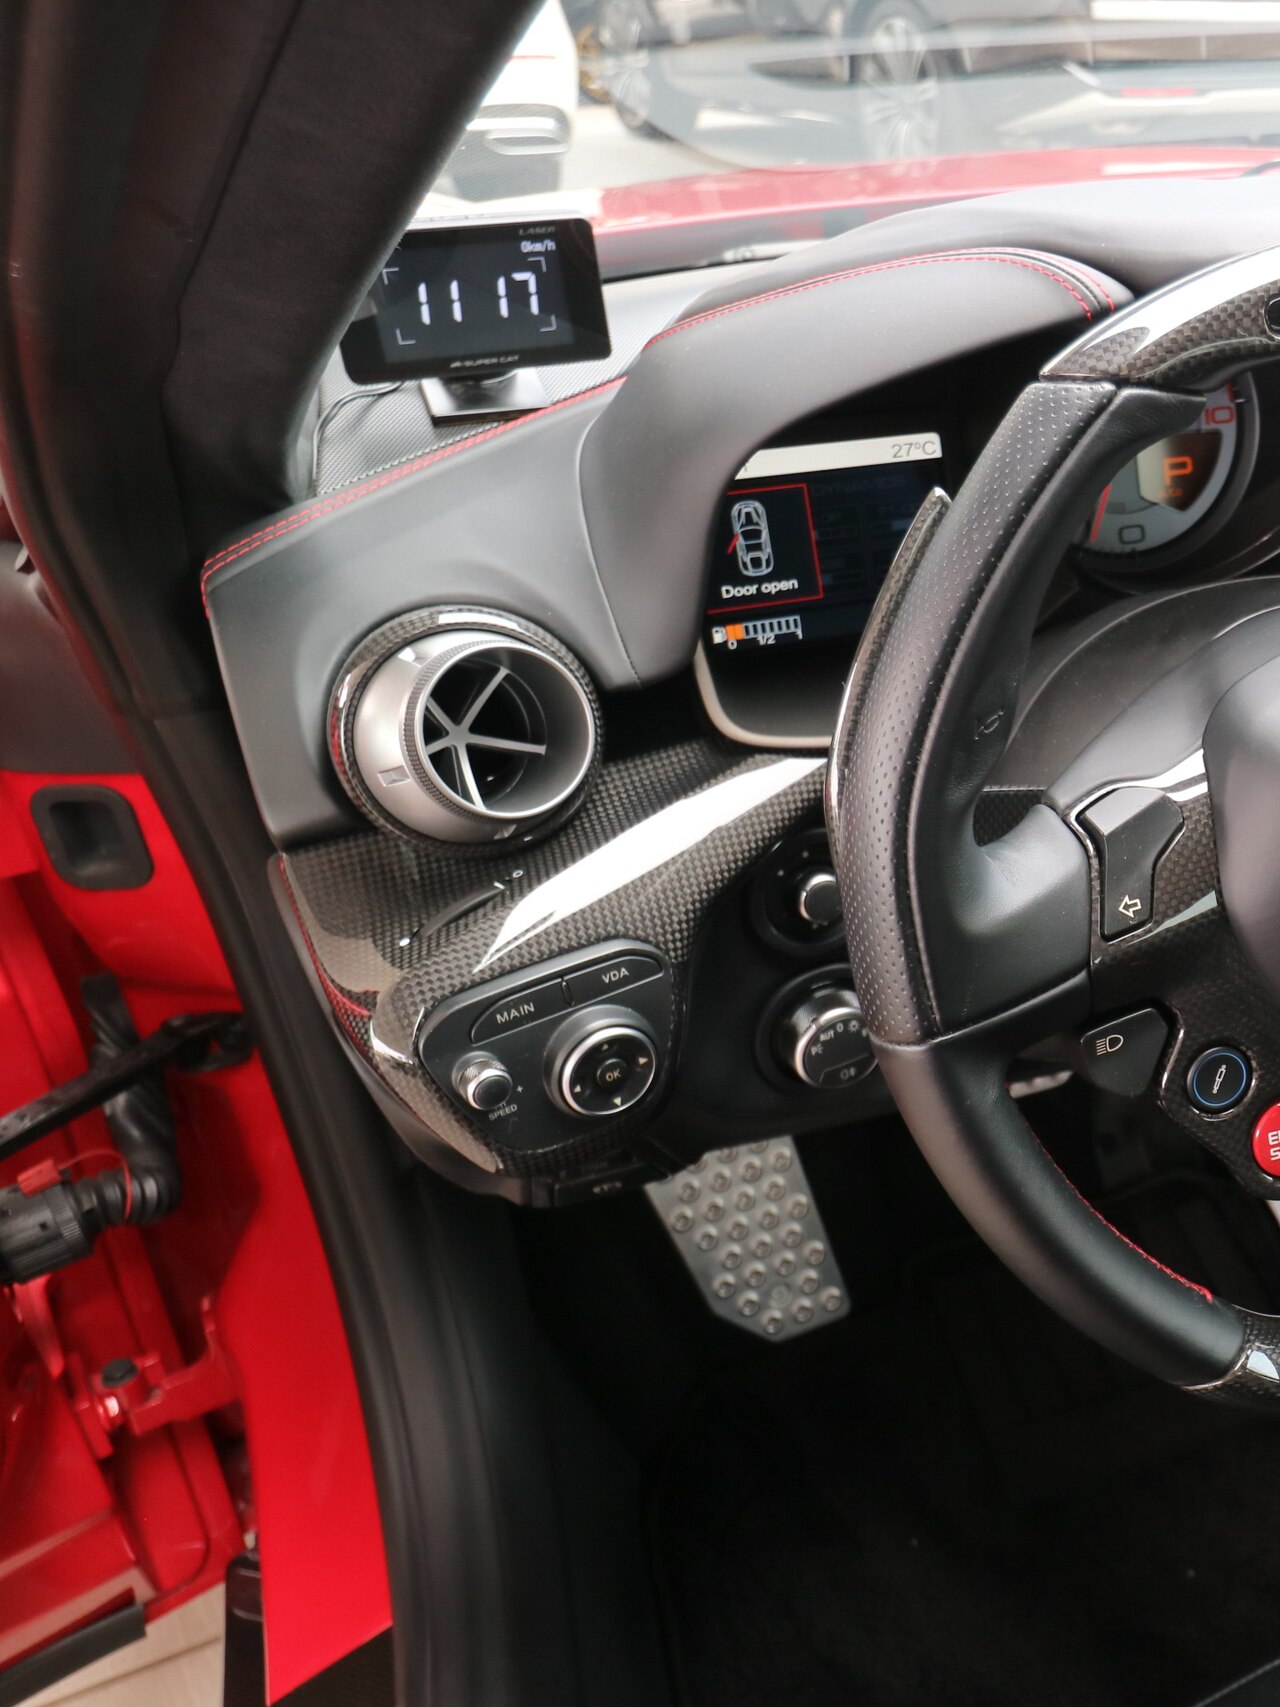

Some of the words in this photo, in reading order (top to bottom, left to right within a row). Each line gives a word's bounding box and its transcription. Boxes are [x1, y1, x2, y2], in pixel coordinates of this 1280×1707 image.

[519, 225, 556, 236] LASER
[1204, 405, 1236, 426] 10
[1162, 455, 1195, 487] P
[721, 583, 759, 600] Door
[761, 579, 799, 595] open
[757, 634, 776, 647] 1/2
[601, 967, 630, 984] VDA
[496, 1002, 536, 1025] MAIN
[605, 1068, 622, 1082] OK
[488, 1104, 518, 1121] SPEED
